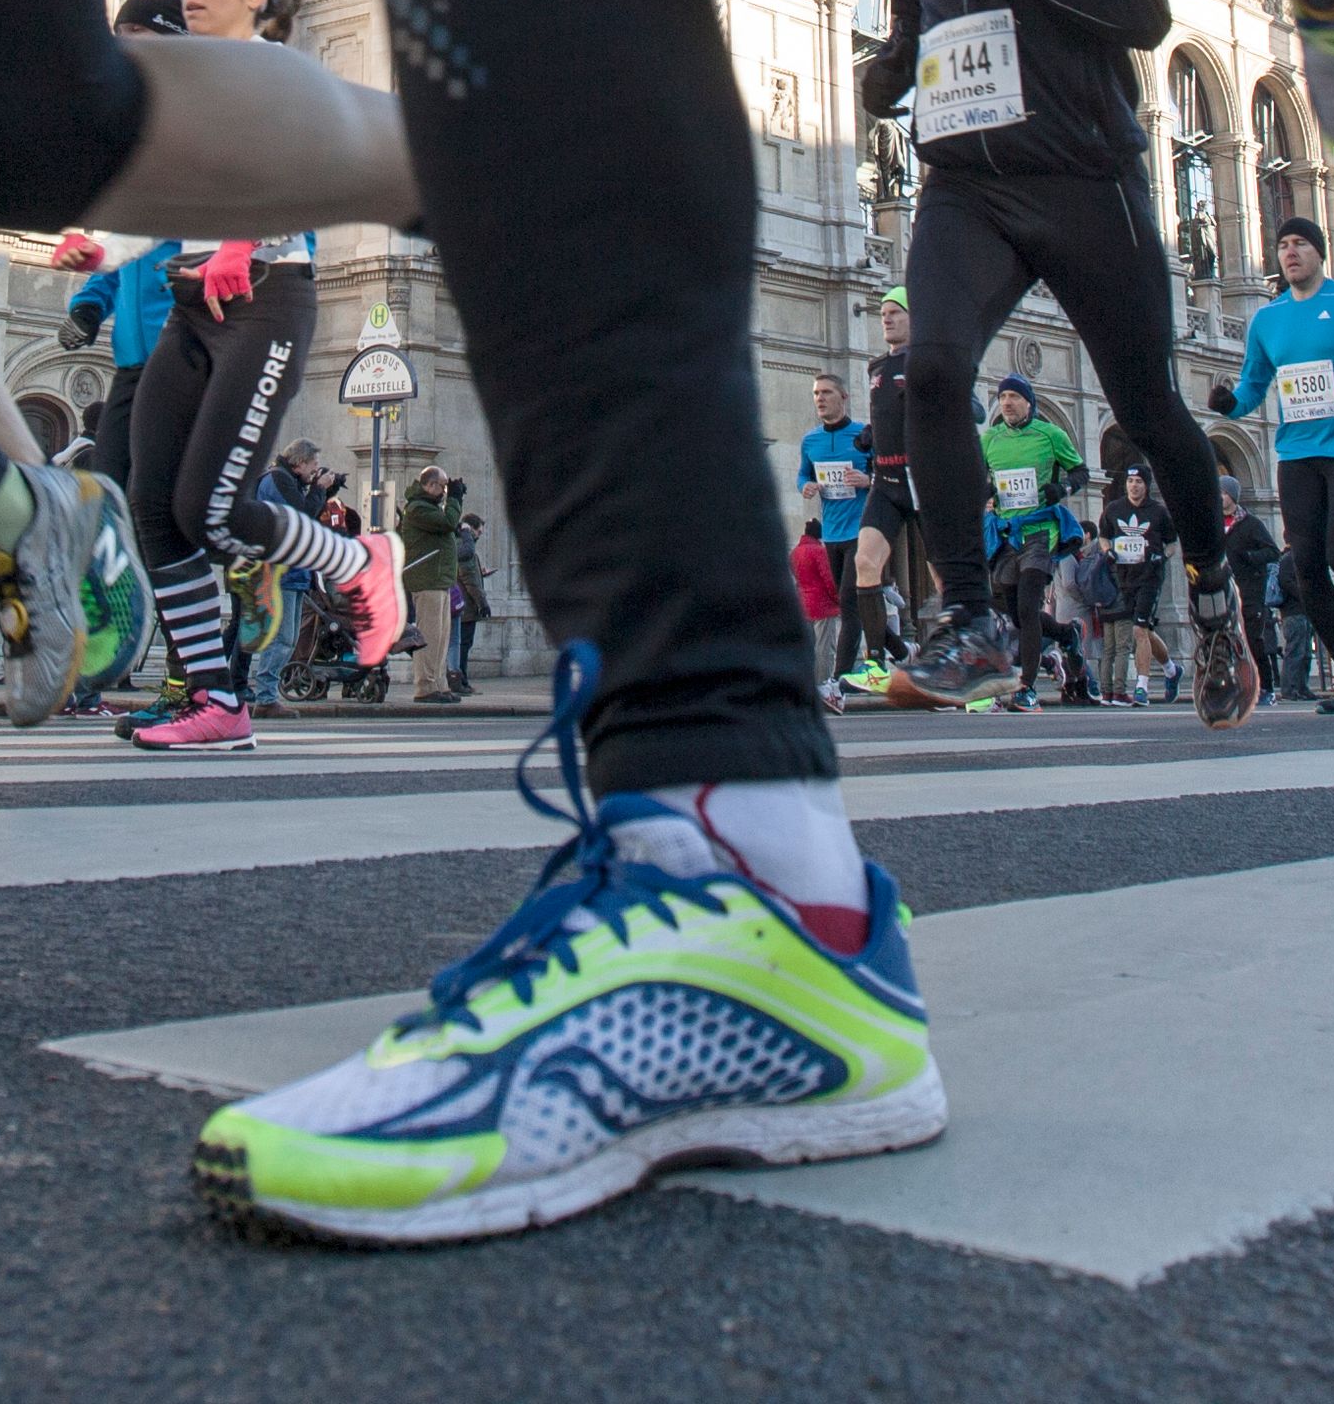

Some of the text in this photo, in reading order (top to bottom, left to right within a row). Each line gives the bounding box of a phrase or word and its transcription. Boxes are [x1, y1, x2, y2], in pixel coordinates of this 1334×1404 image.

[949, 41, 992, 81] 144
[930, 82, 997, 106] Hannes
[933, 107, 999, 133] LCC-Wien
[374, 308, 385, 324] H
[359, 355, 400, 372] AUTOBUS
[351, 381, 406, 395] HALTESTELLE
[1294, 374, 1326, 395] 1580
[1289, 395, 1324, 405] Markus
[205, 446, 254, 527] NEVER
[238, 340, 293, 444] BEFORE.
[826, 470, 848, 483] 132
[1008, 477, 1030, 491] 1517
